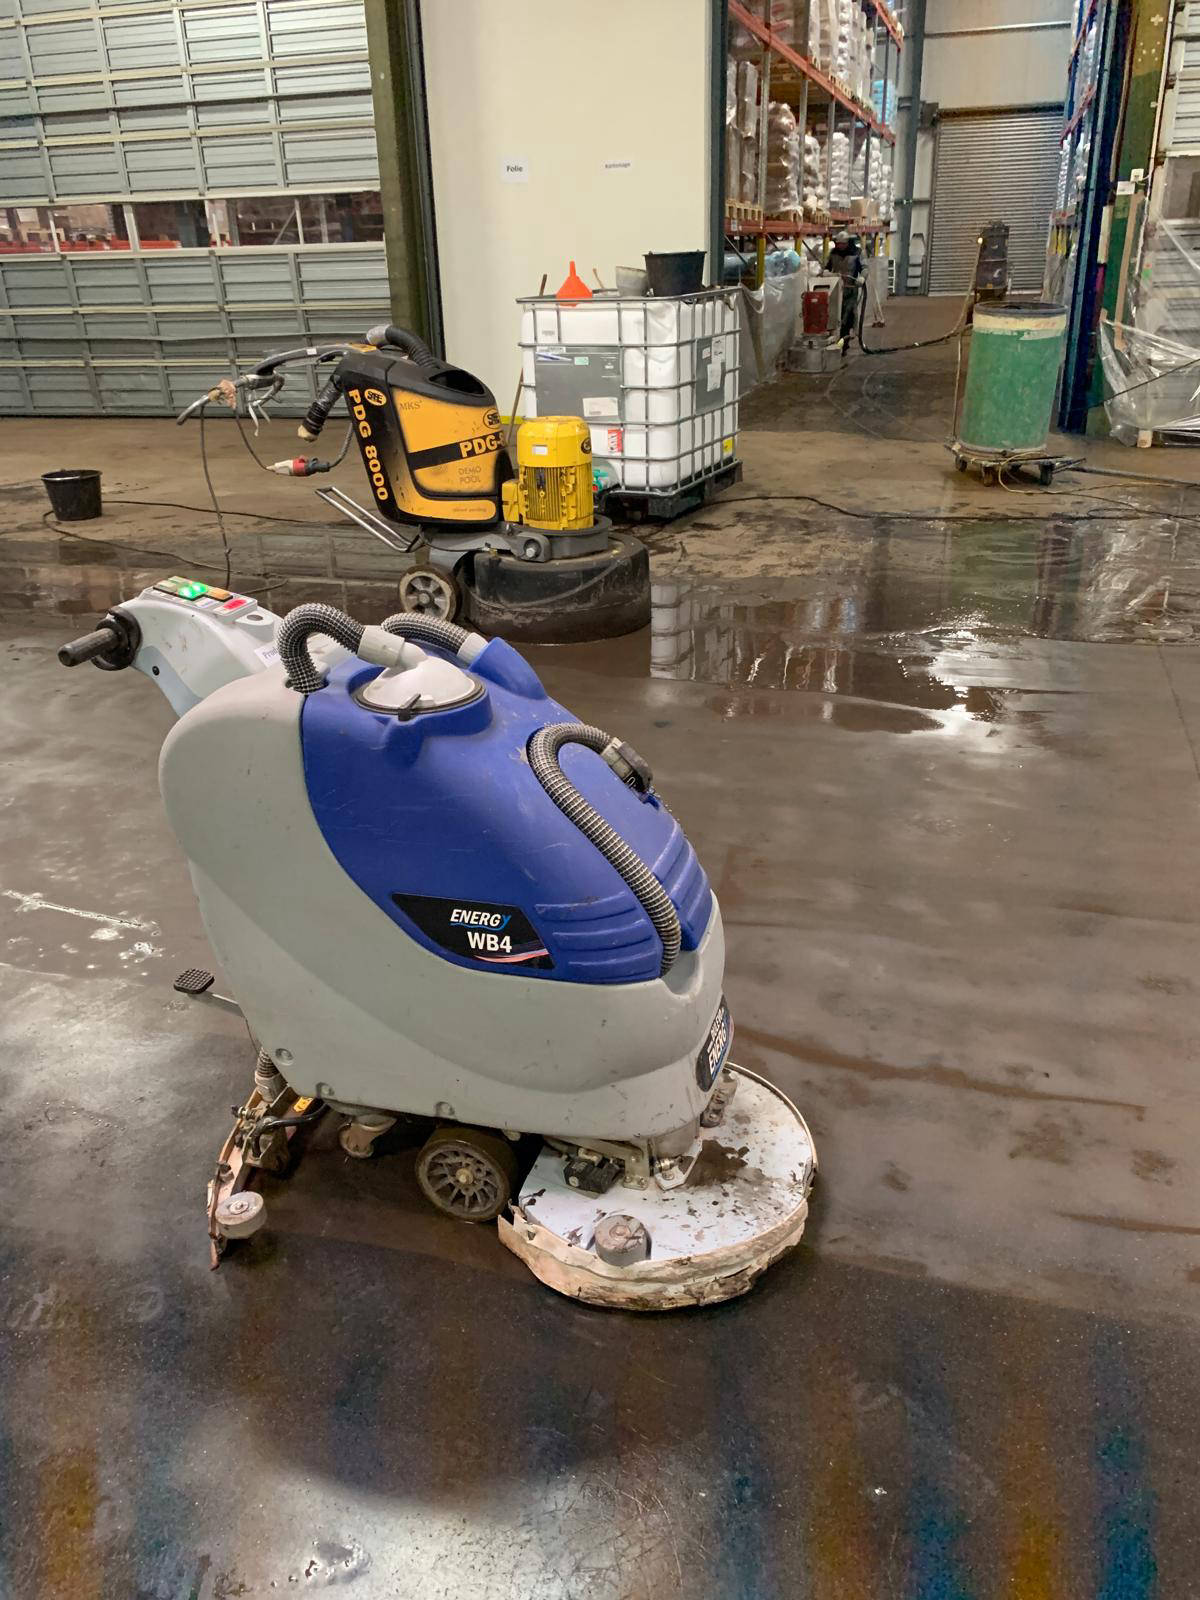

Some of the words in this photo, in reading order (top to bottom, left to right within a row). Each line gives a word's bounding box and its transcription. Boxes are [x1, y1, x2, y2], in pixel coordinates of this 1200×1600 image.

[348, 389, 371, 438] PDG
[365, 445, 389, 500] 8000
[458, 466, 482, 475] DEMO
[459, 476, 481, 485] POOL
[467, 931, 512, 953] WB4
